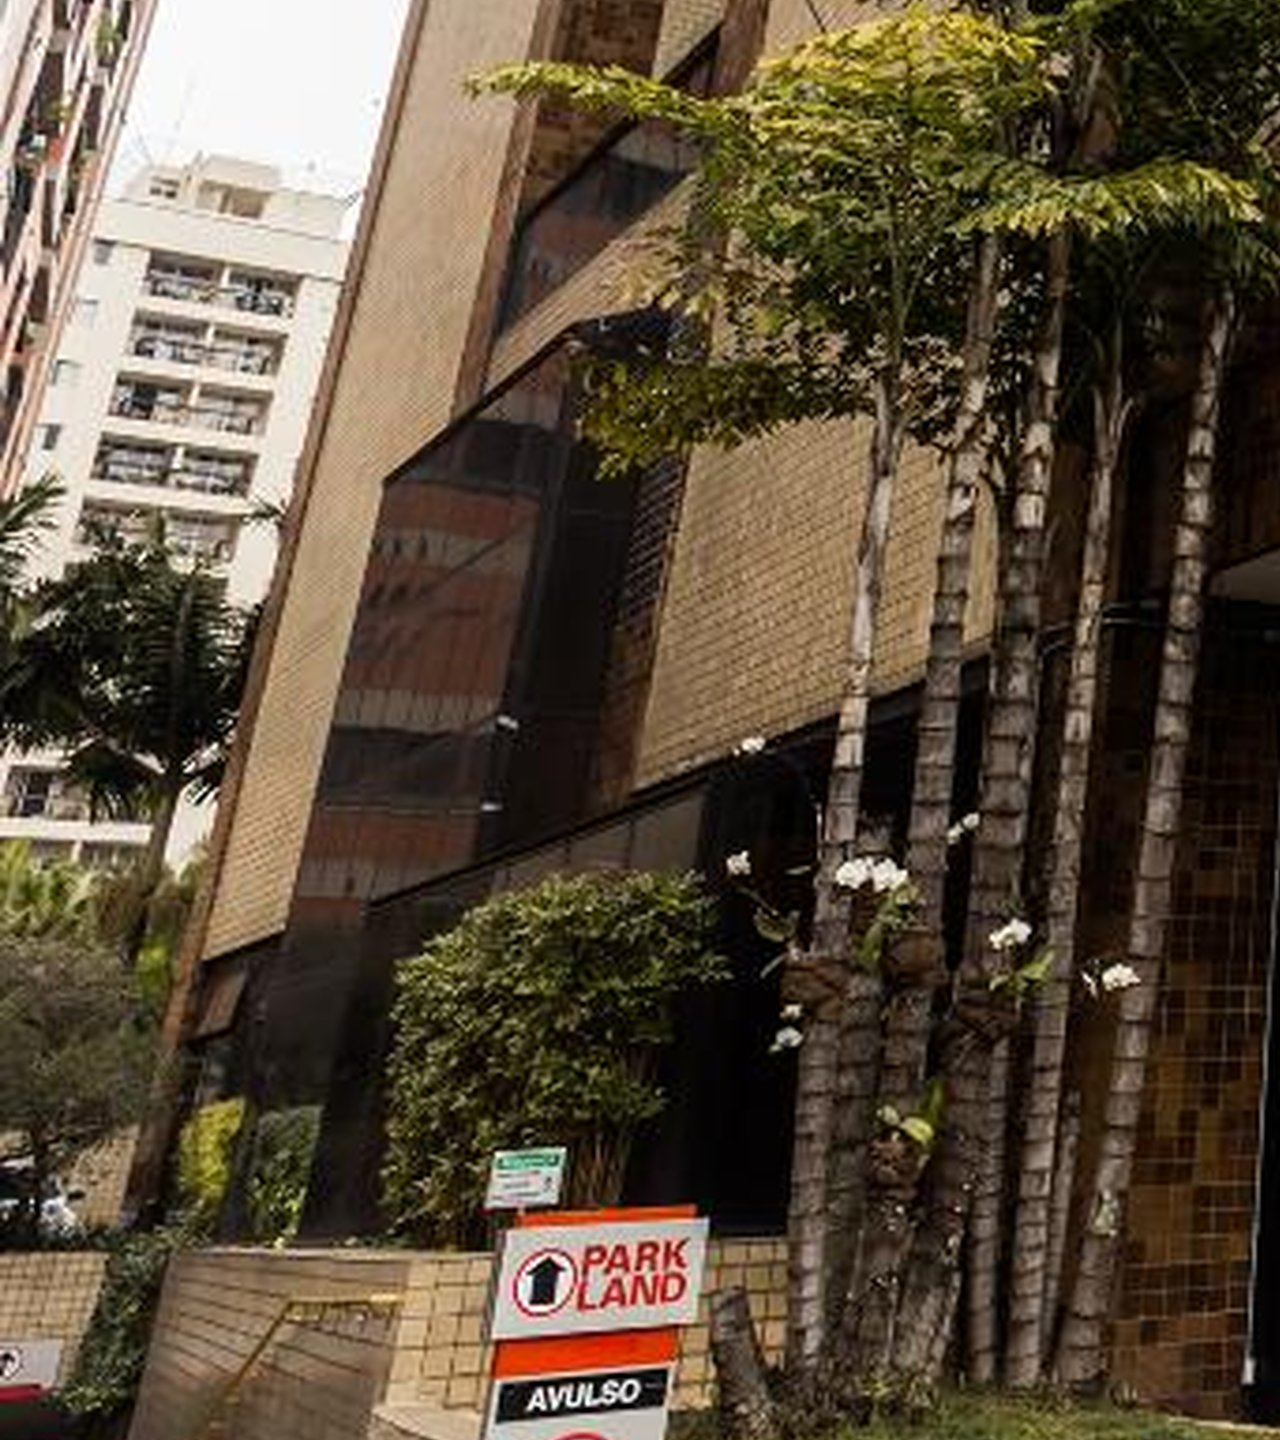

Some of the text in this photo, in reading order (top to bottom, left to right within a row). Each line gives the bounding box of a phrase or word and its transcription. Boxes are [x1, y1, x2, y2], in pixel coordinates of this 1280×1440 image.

[582, 1237, 691, 1278] PARK
[577, 1273, 687, 1311] LAND
[525, 1377, 642, 1412] AVULSO
